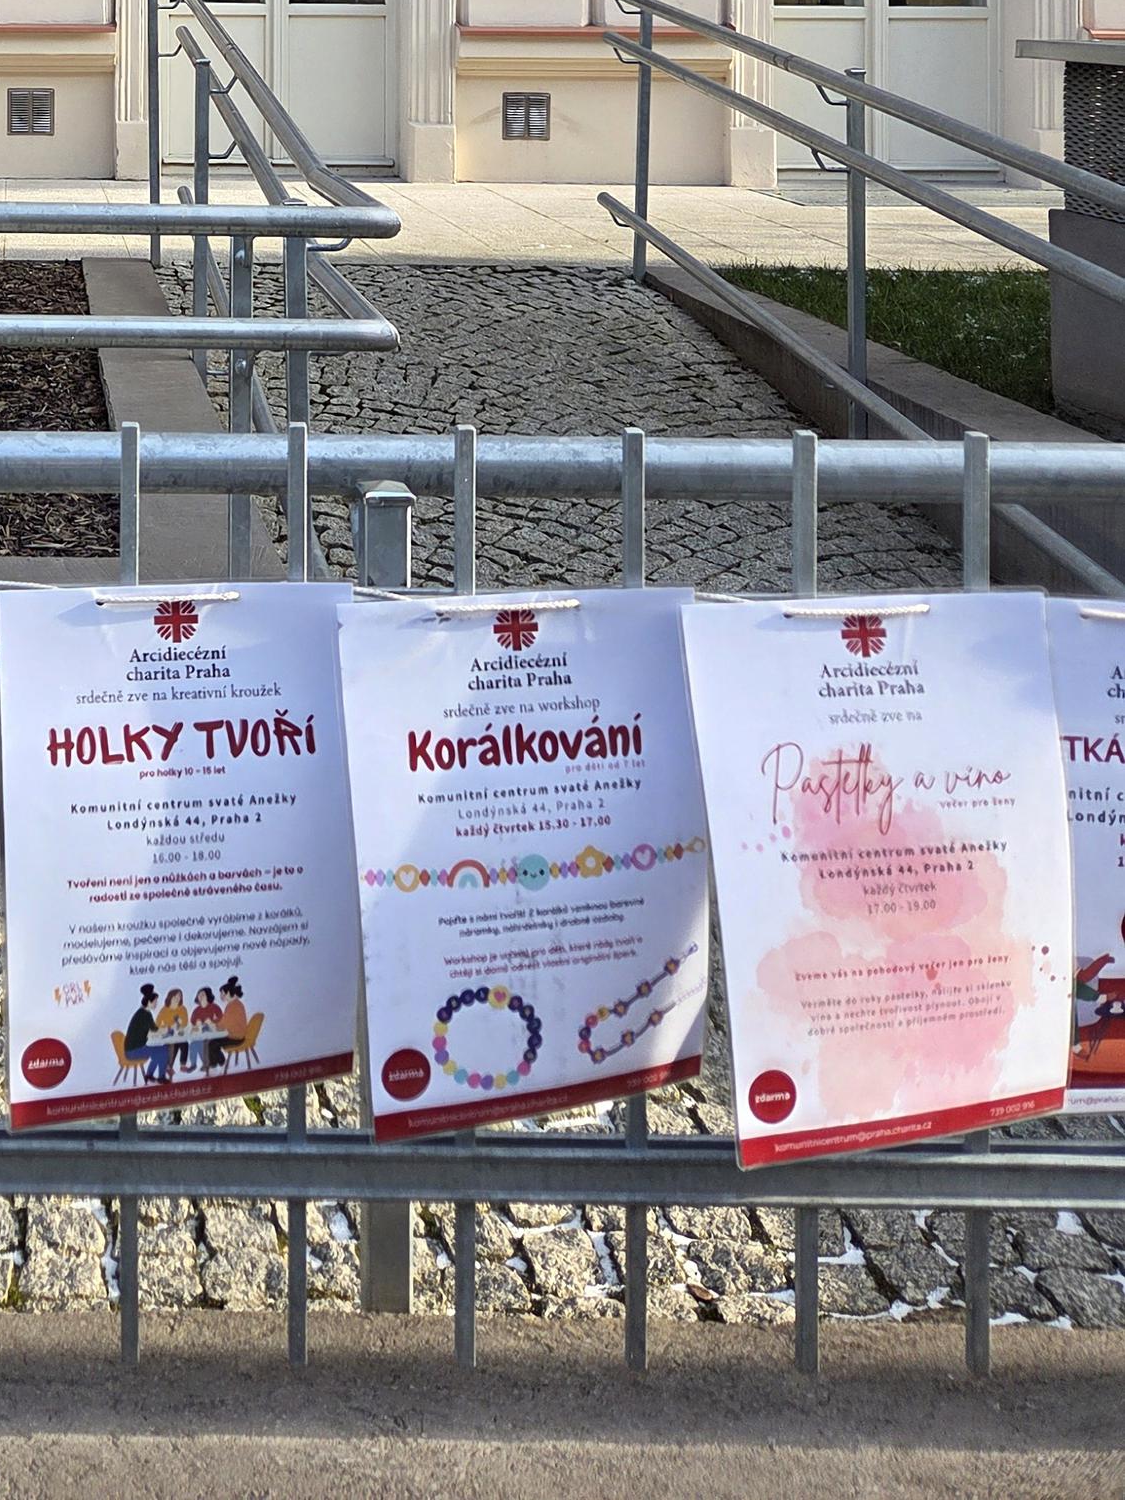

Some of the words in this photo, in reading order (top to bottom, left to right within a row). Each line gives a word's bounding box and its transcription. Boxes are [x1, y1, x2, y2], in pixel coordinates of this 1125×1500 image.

[129, 645, 226, 663] Arcidiecézní
[470, 651, 567, 672] Arcidiecézní
[126, 665, 181, 681] charita
[185, 663, 231, 679] Praha
[820, 659, 919, 679] Arcidiecézní
[467, 674, 522, 691] charita
[526, 670, 572, 687] Praha
[818, 681, 874, 698] charita
[876, 679, 925, 696] Praha
[75, 689, 123, 704] srdečně
[127, 692, 148, 702] zve
[152, 691, 167, 701] na
[170, 684, 227, 700] kreativní
[230, 681, 282, 698] kroužek
[443, 702, 491, 718] srdečně
[494, 704, 515, 715] zve
[519, 703, 535, 714] na
[537, 695, 600, 713] workshop
[46, 721, 184, 768] HOLKY
[192, 709, 316, 760] TVOŘÍ
[407, 712, 642, 772] Korálkování
[417, 787, 488, 804] Komunitní
[493, 786, 549, 798] centrum
[554, 779, 589, 794] svaté
[594, 777, 641, 791] Anežky
[761, 741, 904, 835] Pastelky
[912, 770, 935, 791] a
[943, 765, 1011, 795] víno
[70, 798, 141, 814] Komunitní
[146, 799, 202, 811] centrum
[208, 793, 244, 808] svaté
[249, 792, 296, 806] Anežky
[106, 814, 179, 831] Londýnská
[185, 815, 205, 827] 44,
[211, 812, 249, 825] Praha
[146, 833, 186, 846] každou
[189, 831, 225, 844] středu
